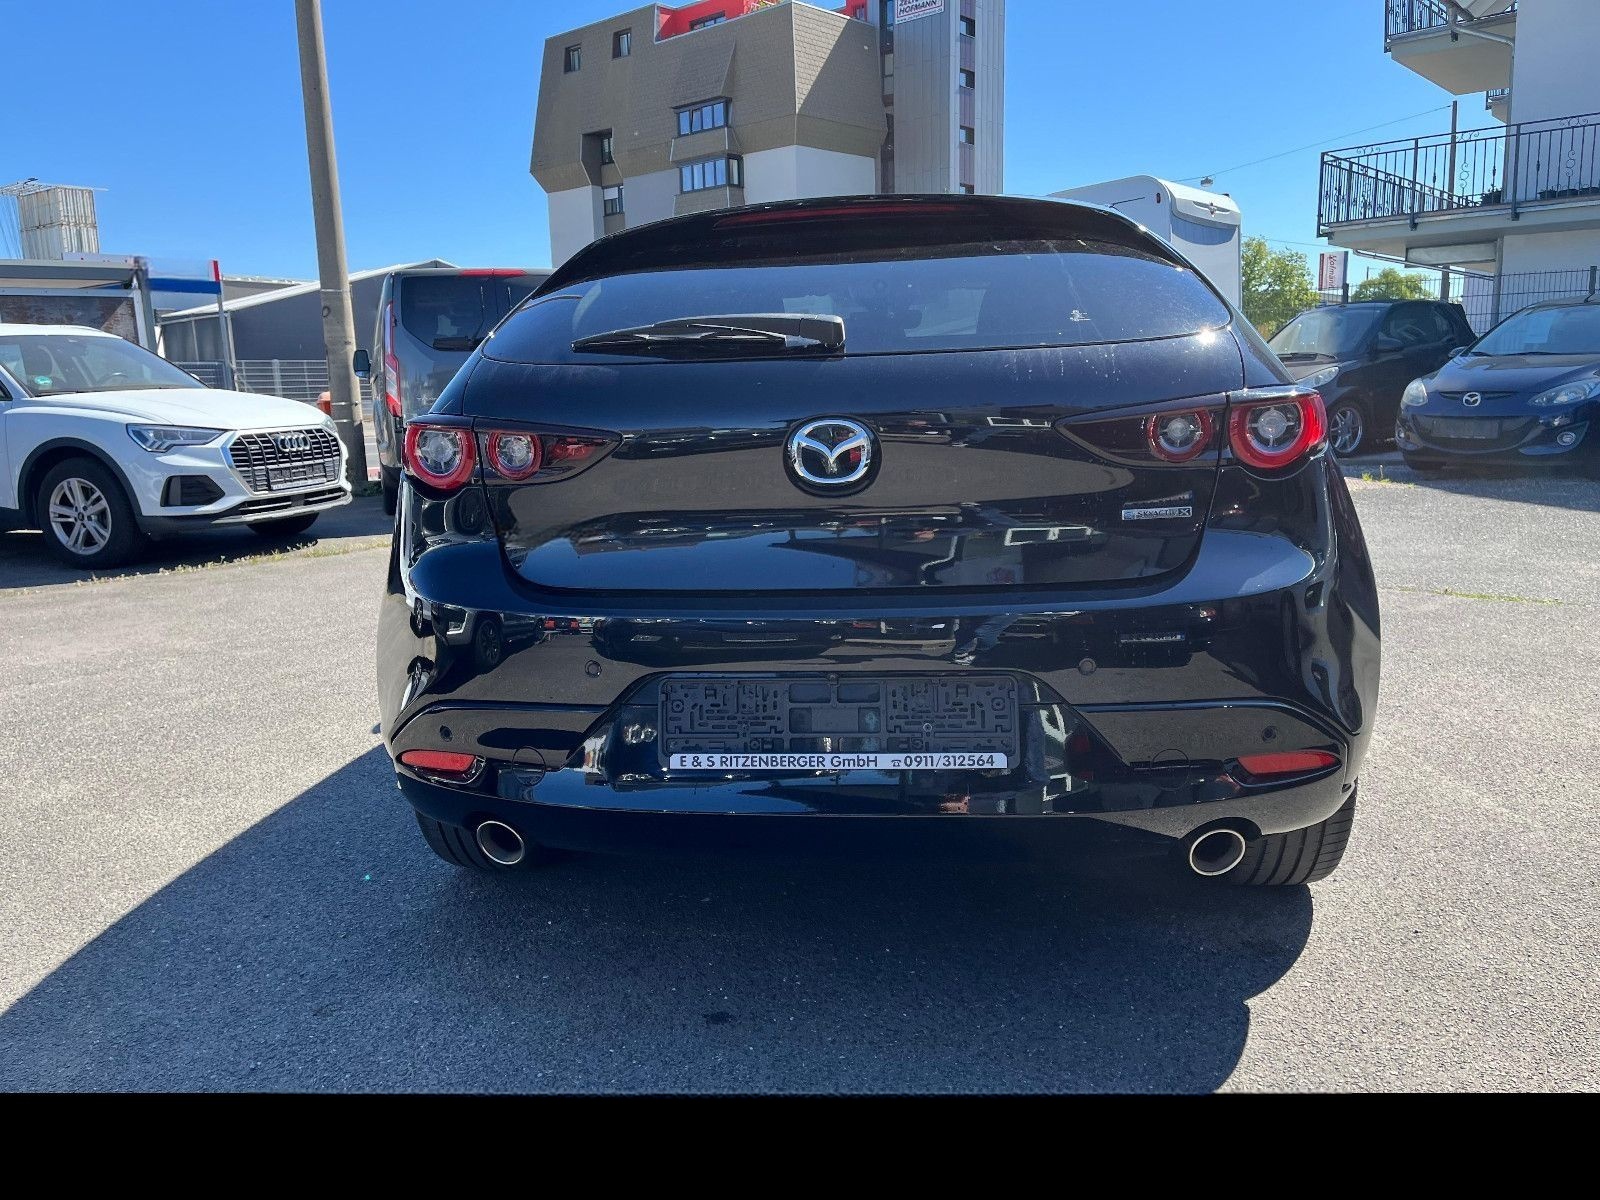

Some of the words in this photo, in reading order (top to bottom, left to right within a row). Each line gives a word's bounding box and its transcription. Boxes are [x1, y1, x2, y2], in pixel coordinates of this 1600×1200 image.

[899, 0, 936, 15] HOFMANN
[680, 755, 687, 767] E
[691, 755, 702, 767] &
[706, 755, 715, 767] S
[720, 755, 825, 767] RITZENBERGER
[830, 755, 878, 767] GmbH
[903, 754, 995, 767] 0911/312564
